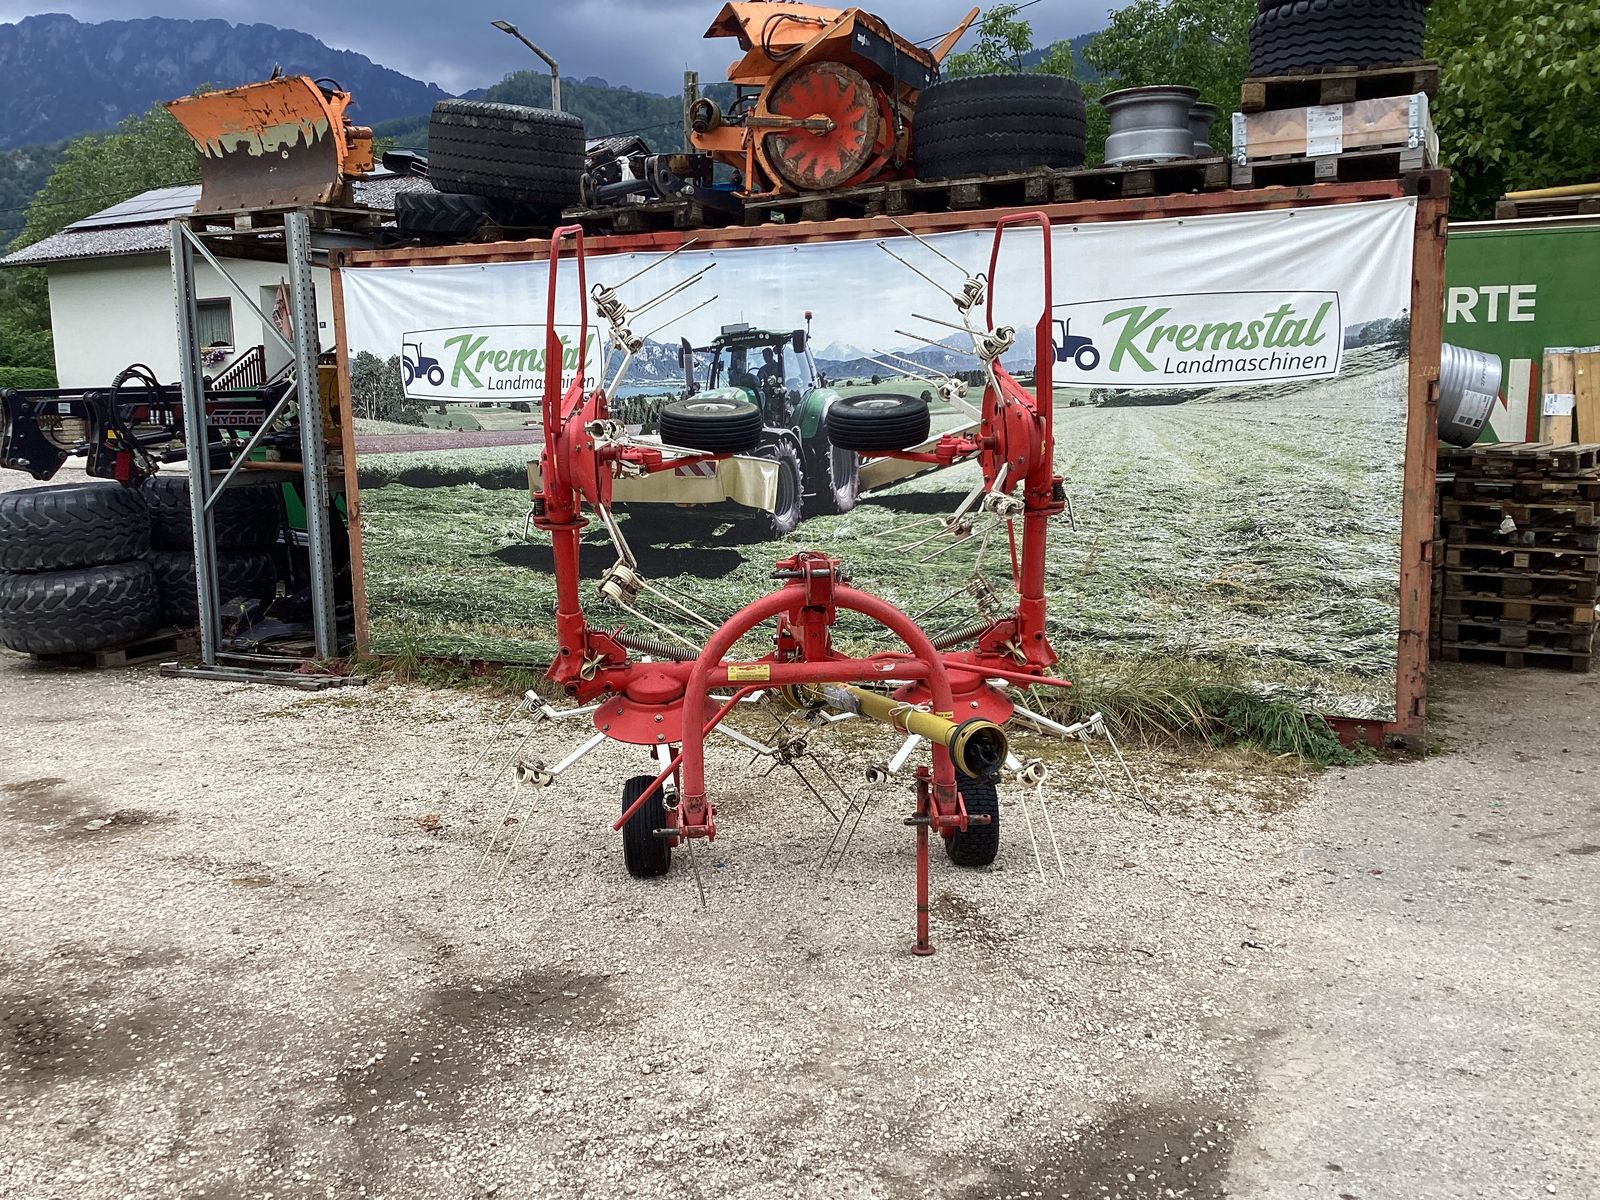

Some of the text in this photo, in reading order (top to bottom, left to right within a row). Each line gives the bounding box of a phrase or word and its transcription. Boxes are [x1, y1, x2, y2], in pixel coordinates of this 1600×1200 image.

[1443, 284, 1537, 323] RTE
[1102, 301, 1333, 373] Kremstal
[1163, 353, 1328, 374] Landmaschinen
[211, 416, 263, 425] HYDRAC
